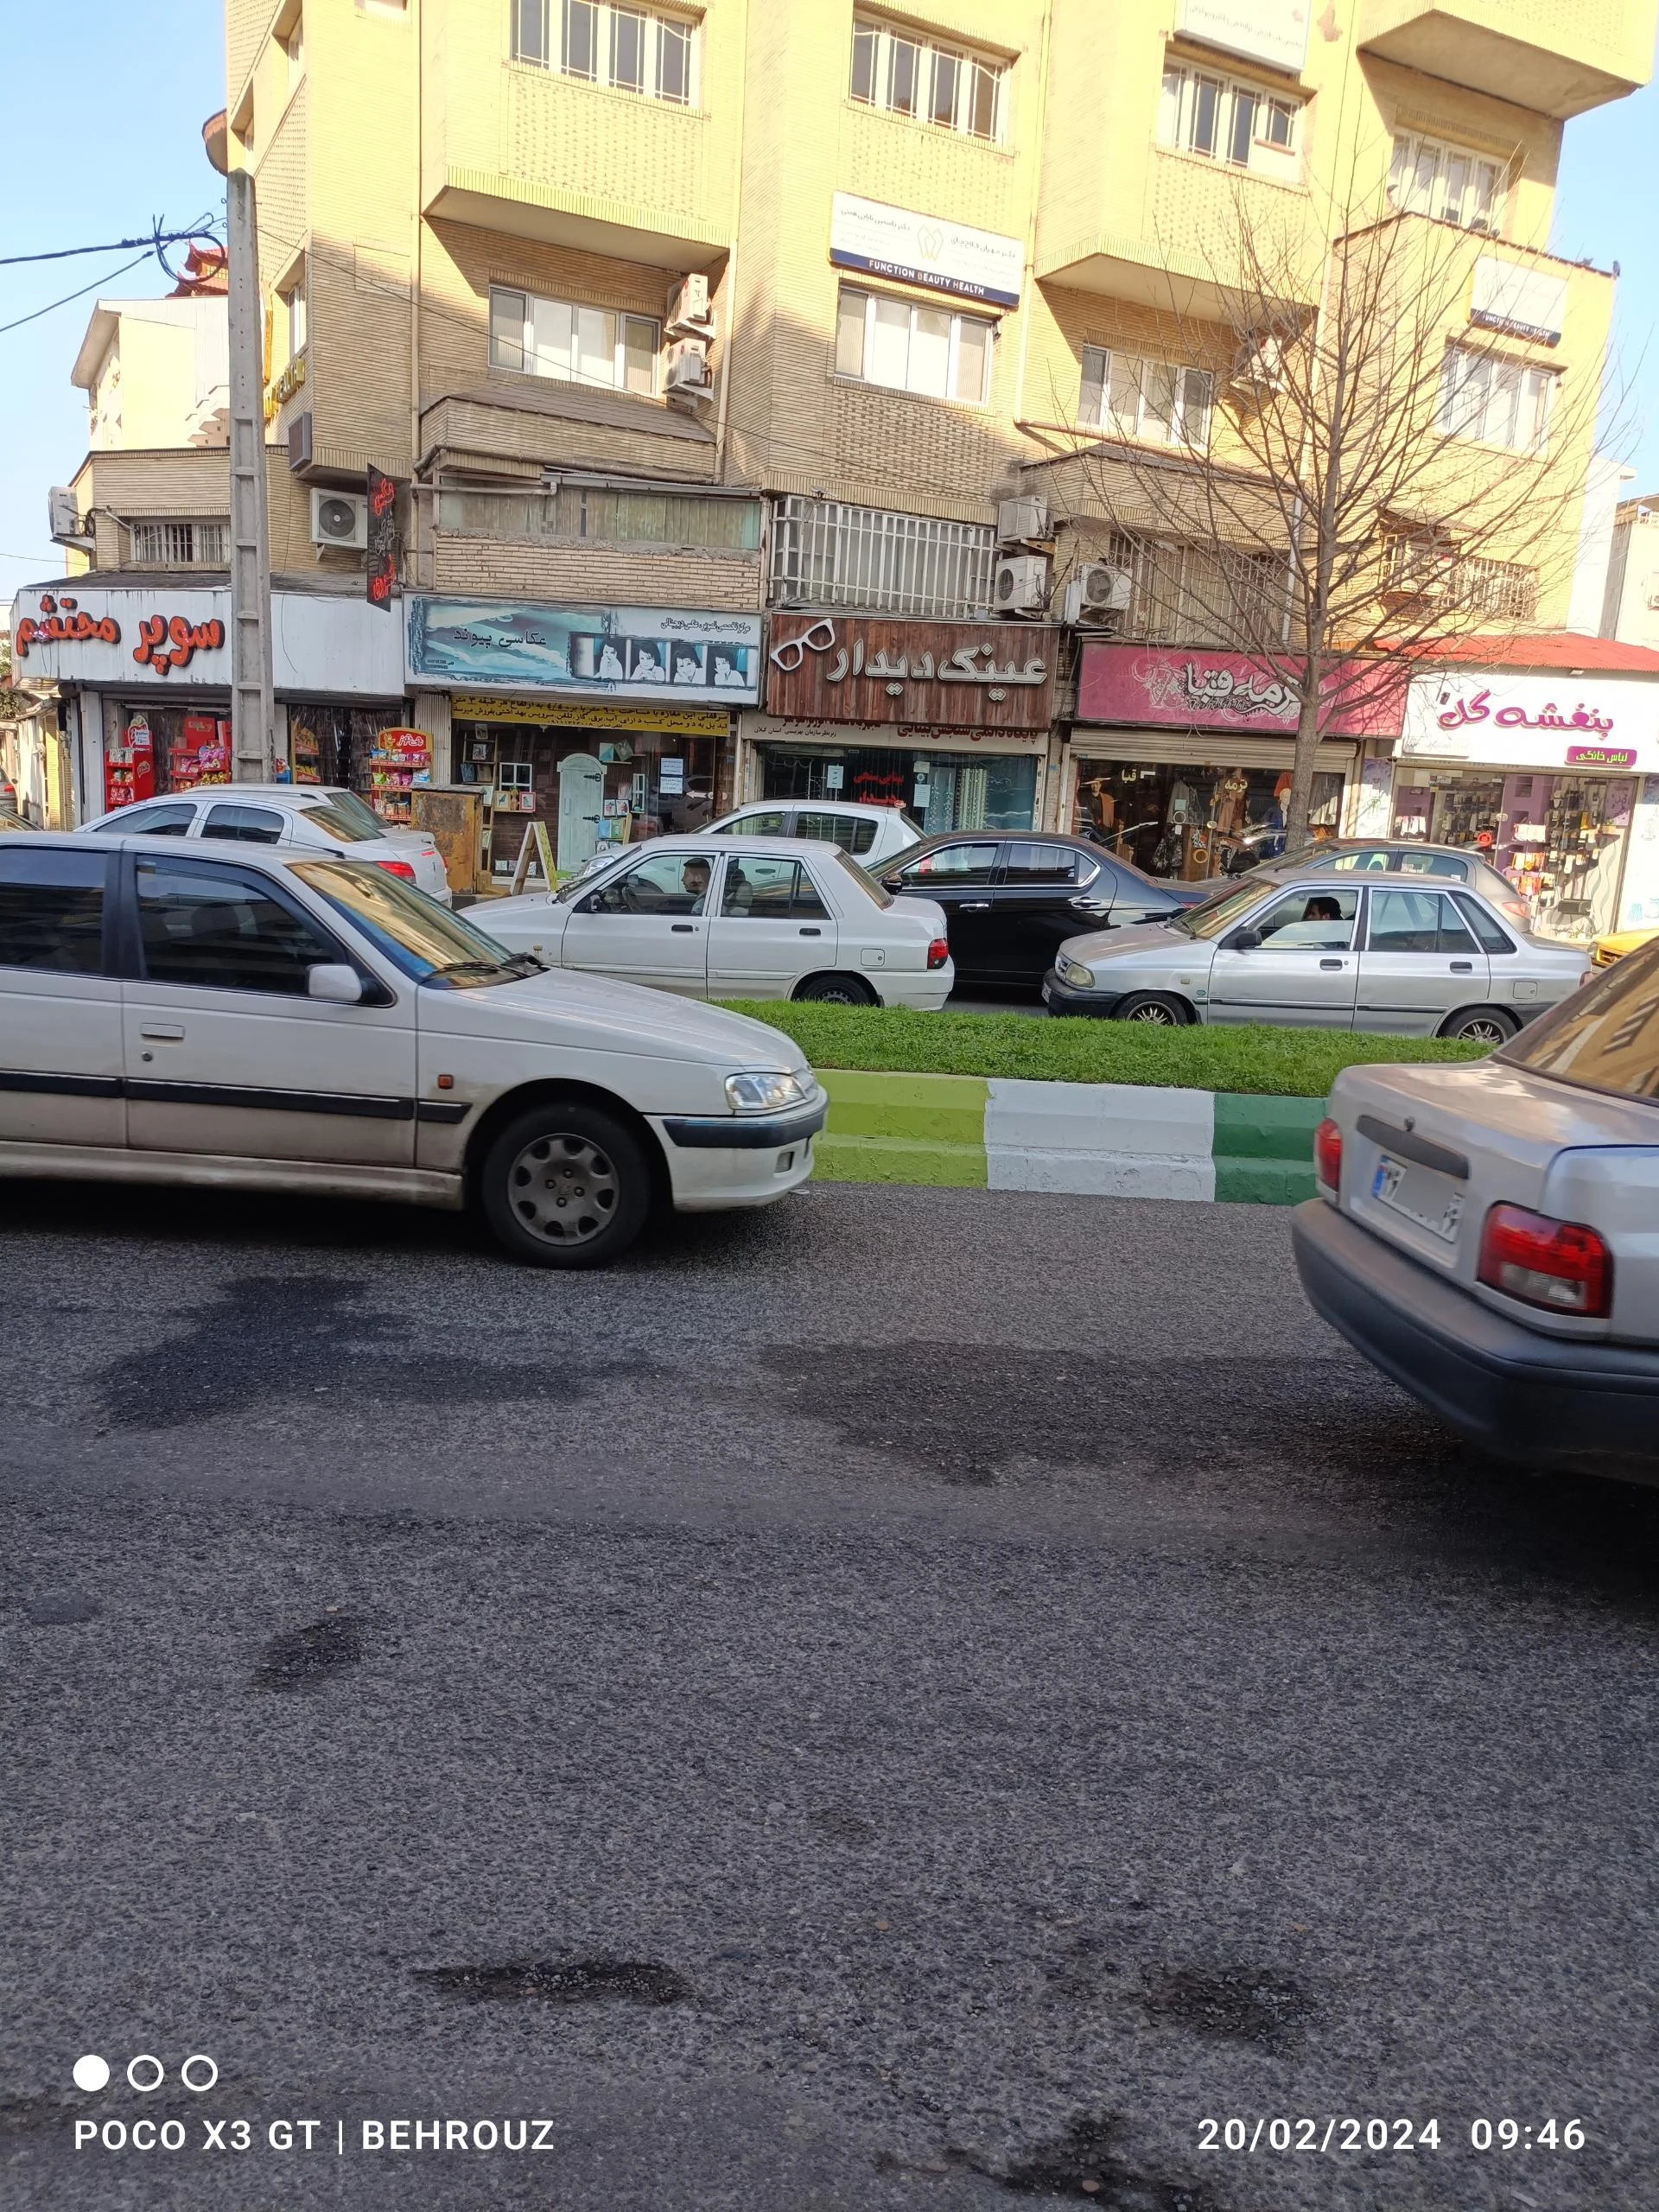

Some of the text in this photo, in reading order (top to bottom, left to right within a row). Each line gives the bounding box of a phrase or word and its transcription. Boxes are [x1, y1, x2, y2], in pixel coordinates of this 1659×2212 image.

[868, 259, 985, 296] FUNCTION BEAUTY HEALTH
[16, 594, 225, 676] سوپر محتشم
[454, 627, 547, 649] عکاسی پیوند
[826, 639, 1047, 701] عینک دیدار
[479, 697, 496, 706] طبقه
[510, 700, 534, 709] ارتفاع
[528, 710, 554, 719] سرویس
[683, 711, 696, 720] این
[698, 712, 728, 722] سرقفلی
[1438, 690, 1614, 739] بنفشه گل
[666, 719, 683, 728] محل
[1606, 752, 1628, 764] لباس
[1121, 768, 1137, 784] قبا
[1224, 779, 1249, 793] ترمه
